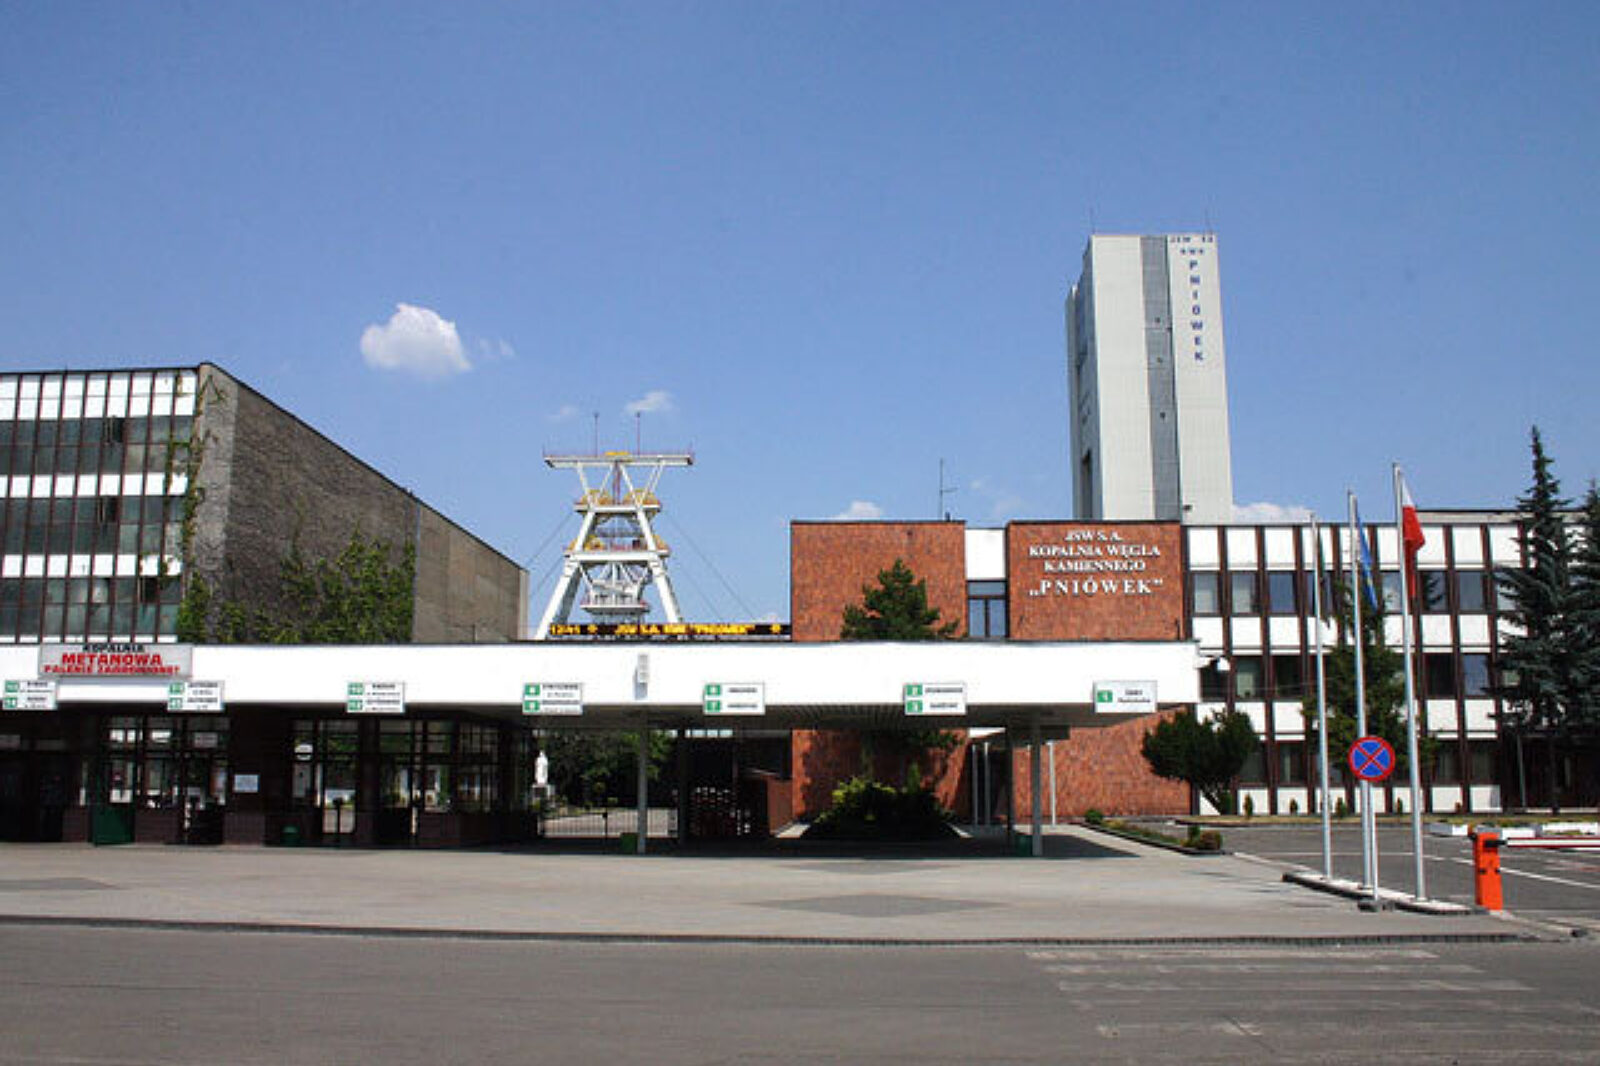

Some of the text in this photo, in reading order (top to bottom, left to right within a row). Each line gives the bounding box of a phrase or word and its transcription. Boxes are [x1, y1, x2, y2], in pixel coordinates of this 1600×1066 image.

[1029, 544, 1161, 558] KOPALNIA WĘGLA
[1044, 559, 1146, 573] KAMIENNEGO
[61, 653, 163, 666] METANOWA
